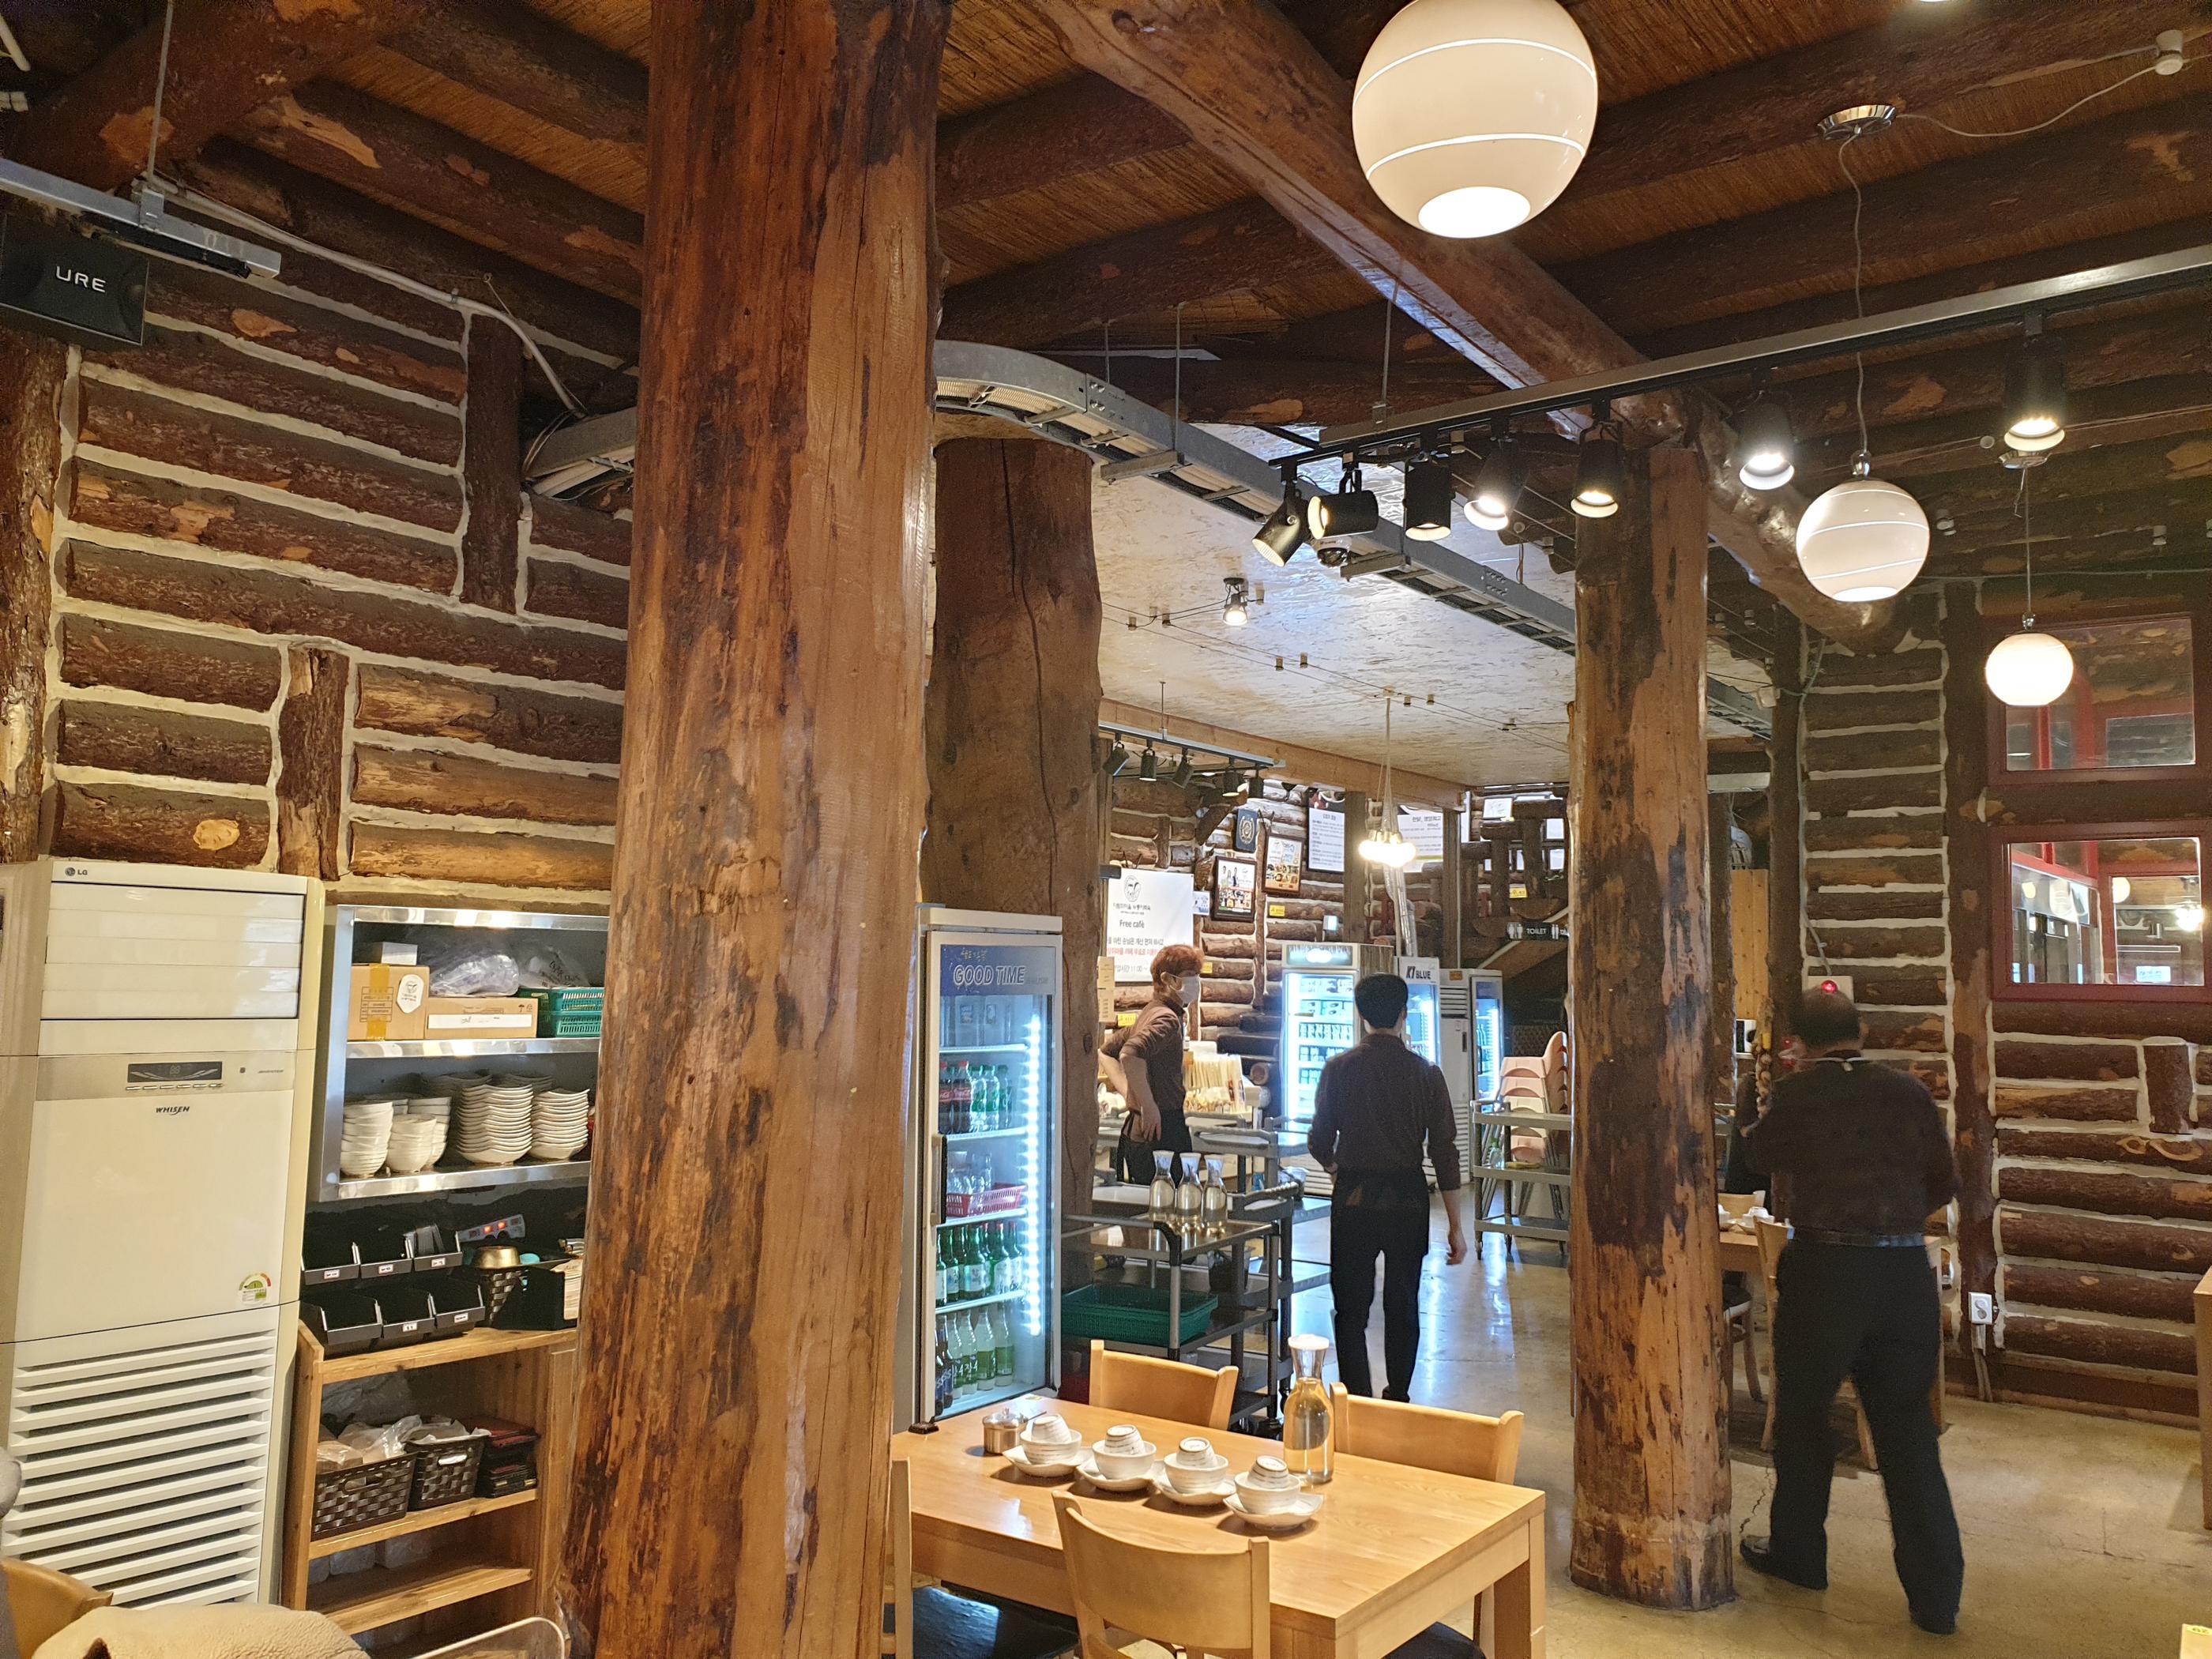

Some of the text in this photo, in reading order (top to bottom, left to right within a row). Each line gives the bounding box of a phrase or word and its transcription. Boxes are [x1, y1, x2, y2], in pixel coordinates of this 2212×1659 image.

[56, 265, 107, 293] URE
[953, 965, 1026, 985] GOOD TIME
[1416, 970, 1431, 980] BLUE
[156, 1106, 190, 1115] WHISEN
